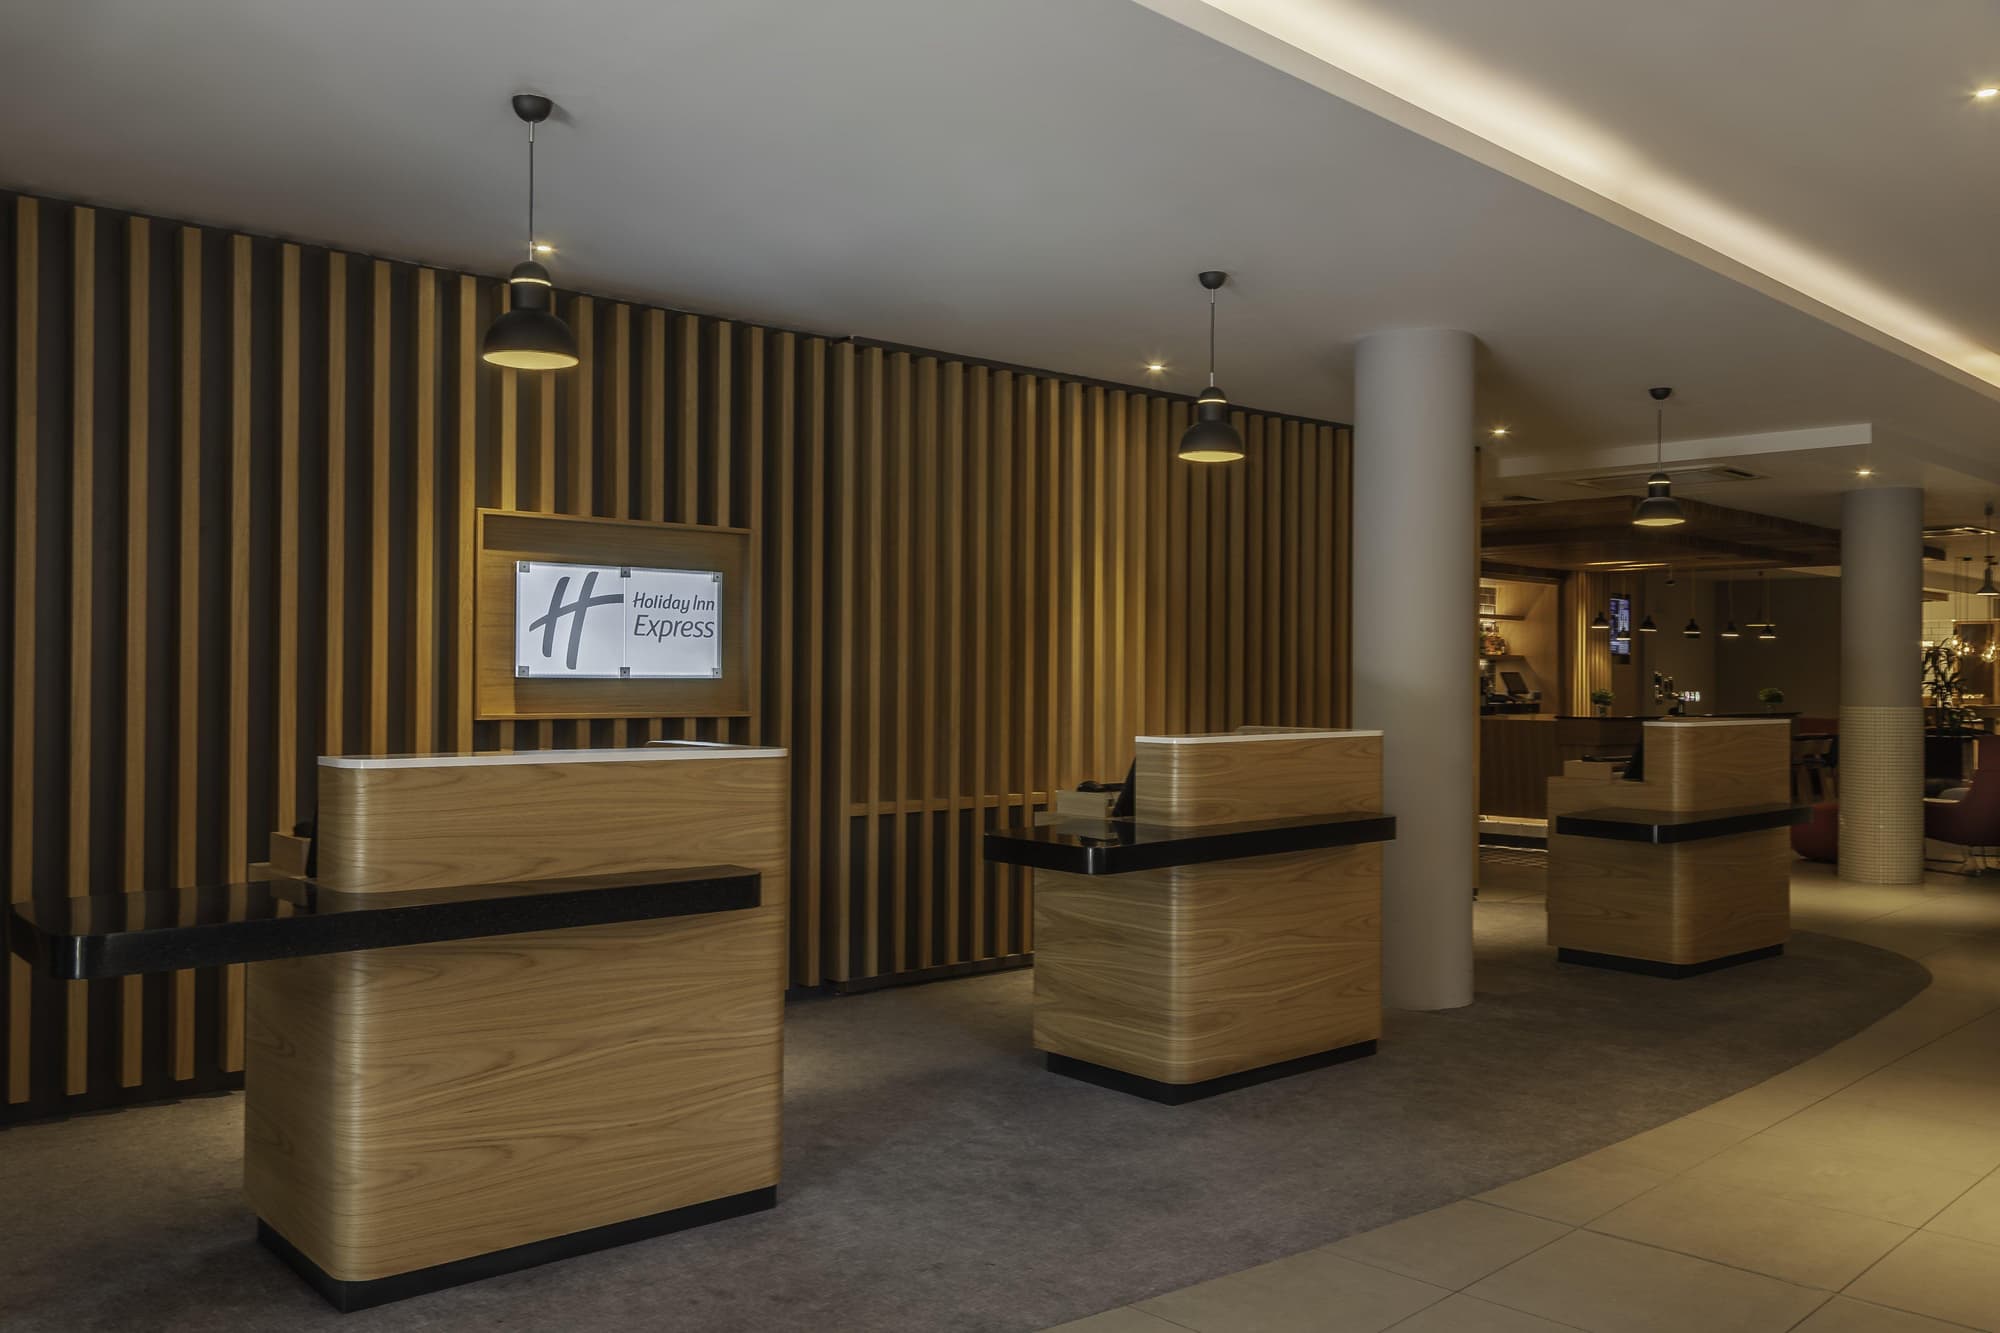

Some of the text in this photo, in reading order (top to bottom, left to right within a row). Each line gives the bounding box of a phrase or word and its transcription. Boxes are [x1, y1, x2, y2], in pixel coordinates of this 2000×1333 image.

[633, 592, 715, 613] Holiday Inn
[634, 615, 715, 643] Express
